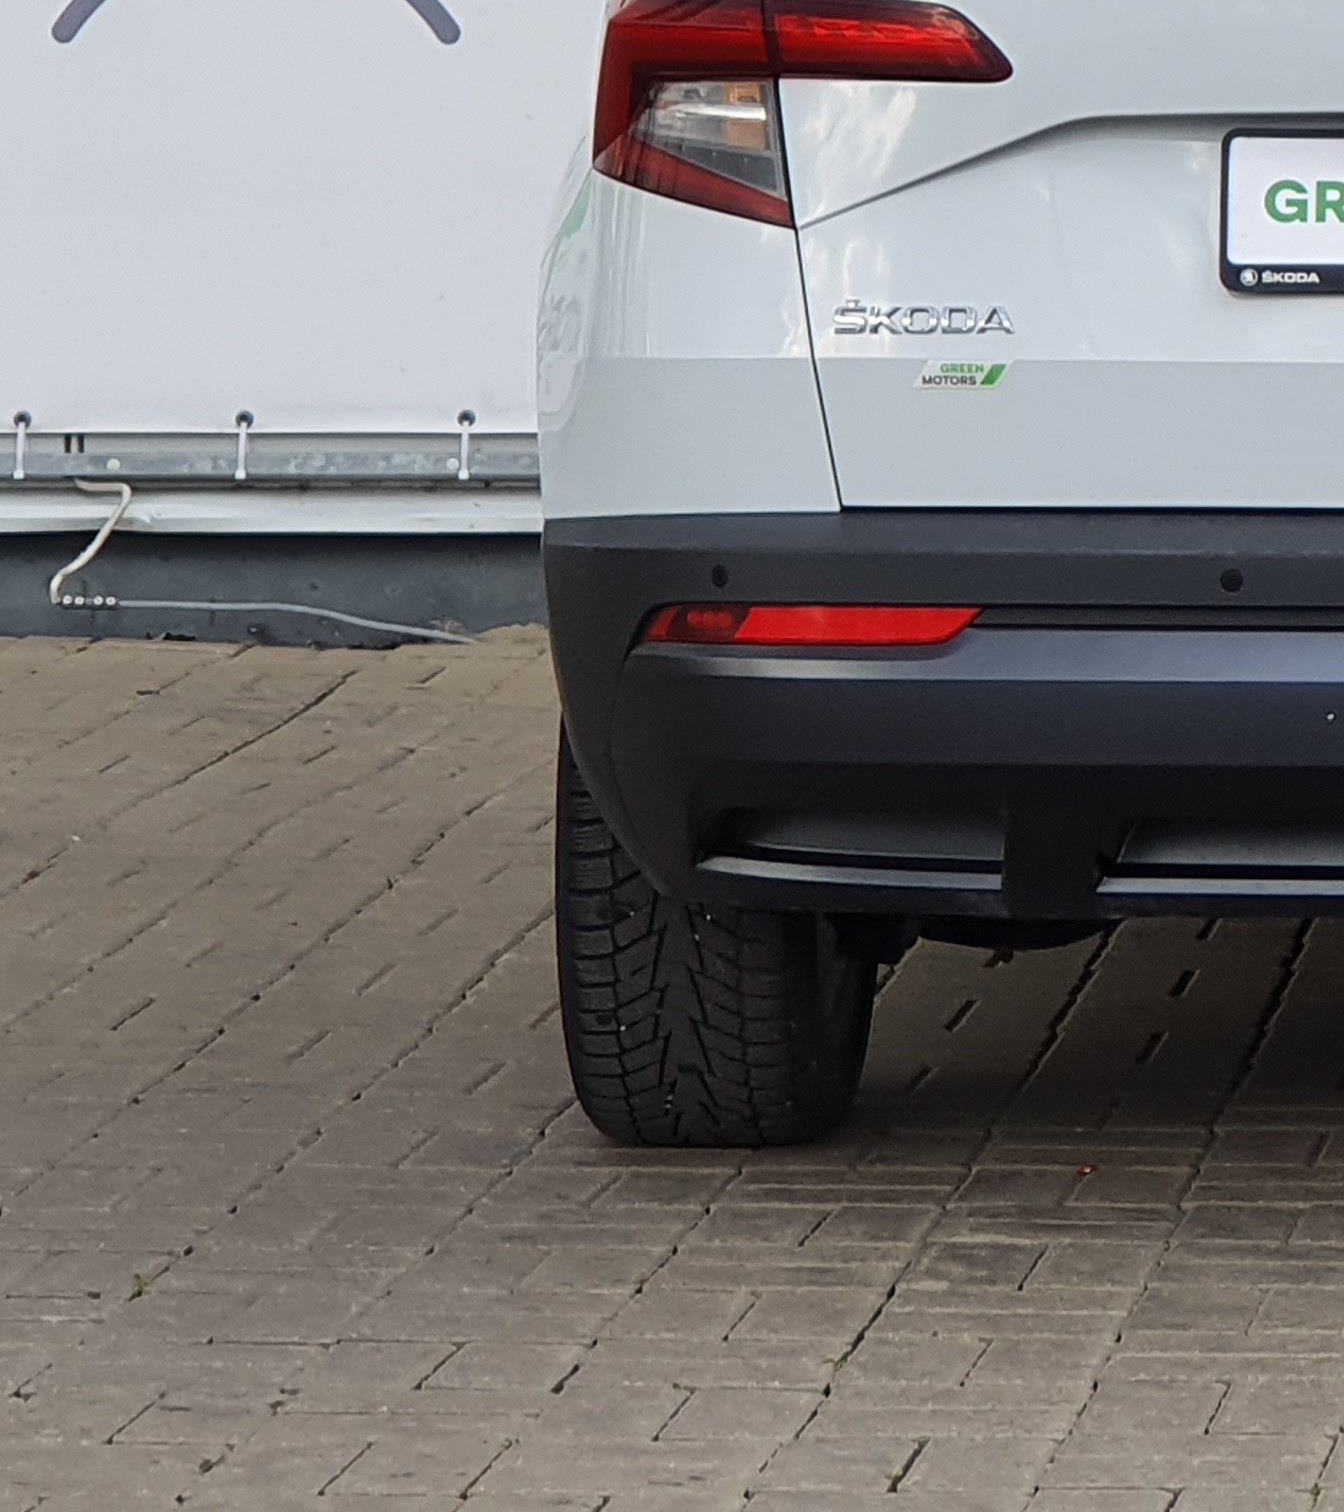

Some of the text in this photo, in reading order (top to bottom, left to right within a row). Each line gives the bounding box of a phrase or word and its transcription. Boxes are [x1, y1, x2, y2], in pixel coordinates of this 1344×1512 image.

[1261, 269, 1321, 284] ŠKODA
[832, 299, 1015, 335] ŠKODA
[940, 362, 985, 374] GREEN
[921, 375, 977, 386] MOTORS
